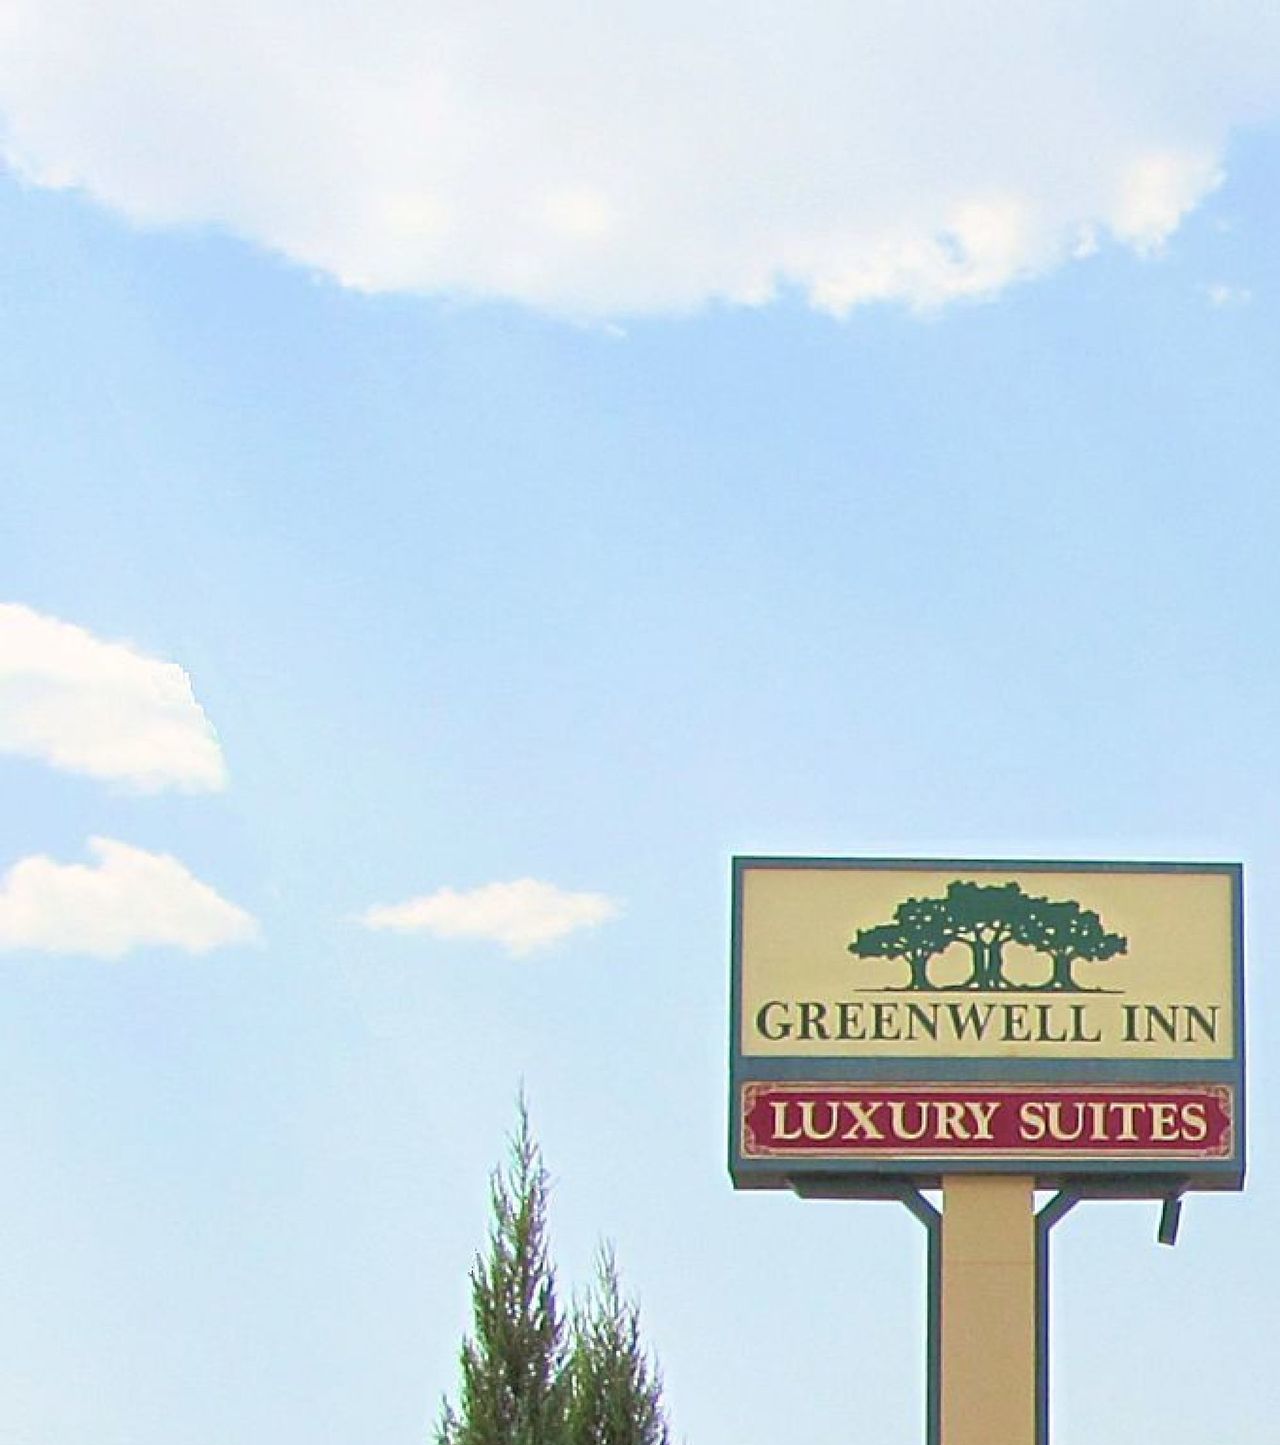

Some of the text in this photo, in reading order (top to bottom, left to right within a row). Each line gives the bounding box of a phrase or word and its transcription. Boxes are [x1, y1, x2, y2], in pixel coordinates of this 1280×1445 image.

[756, 1001, 1221, 1043] GREENWELL INN
[769, 1101, 1208, 1142] LUXURY SUITES
